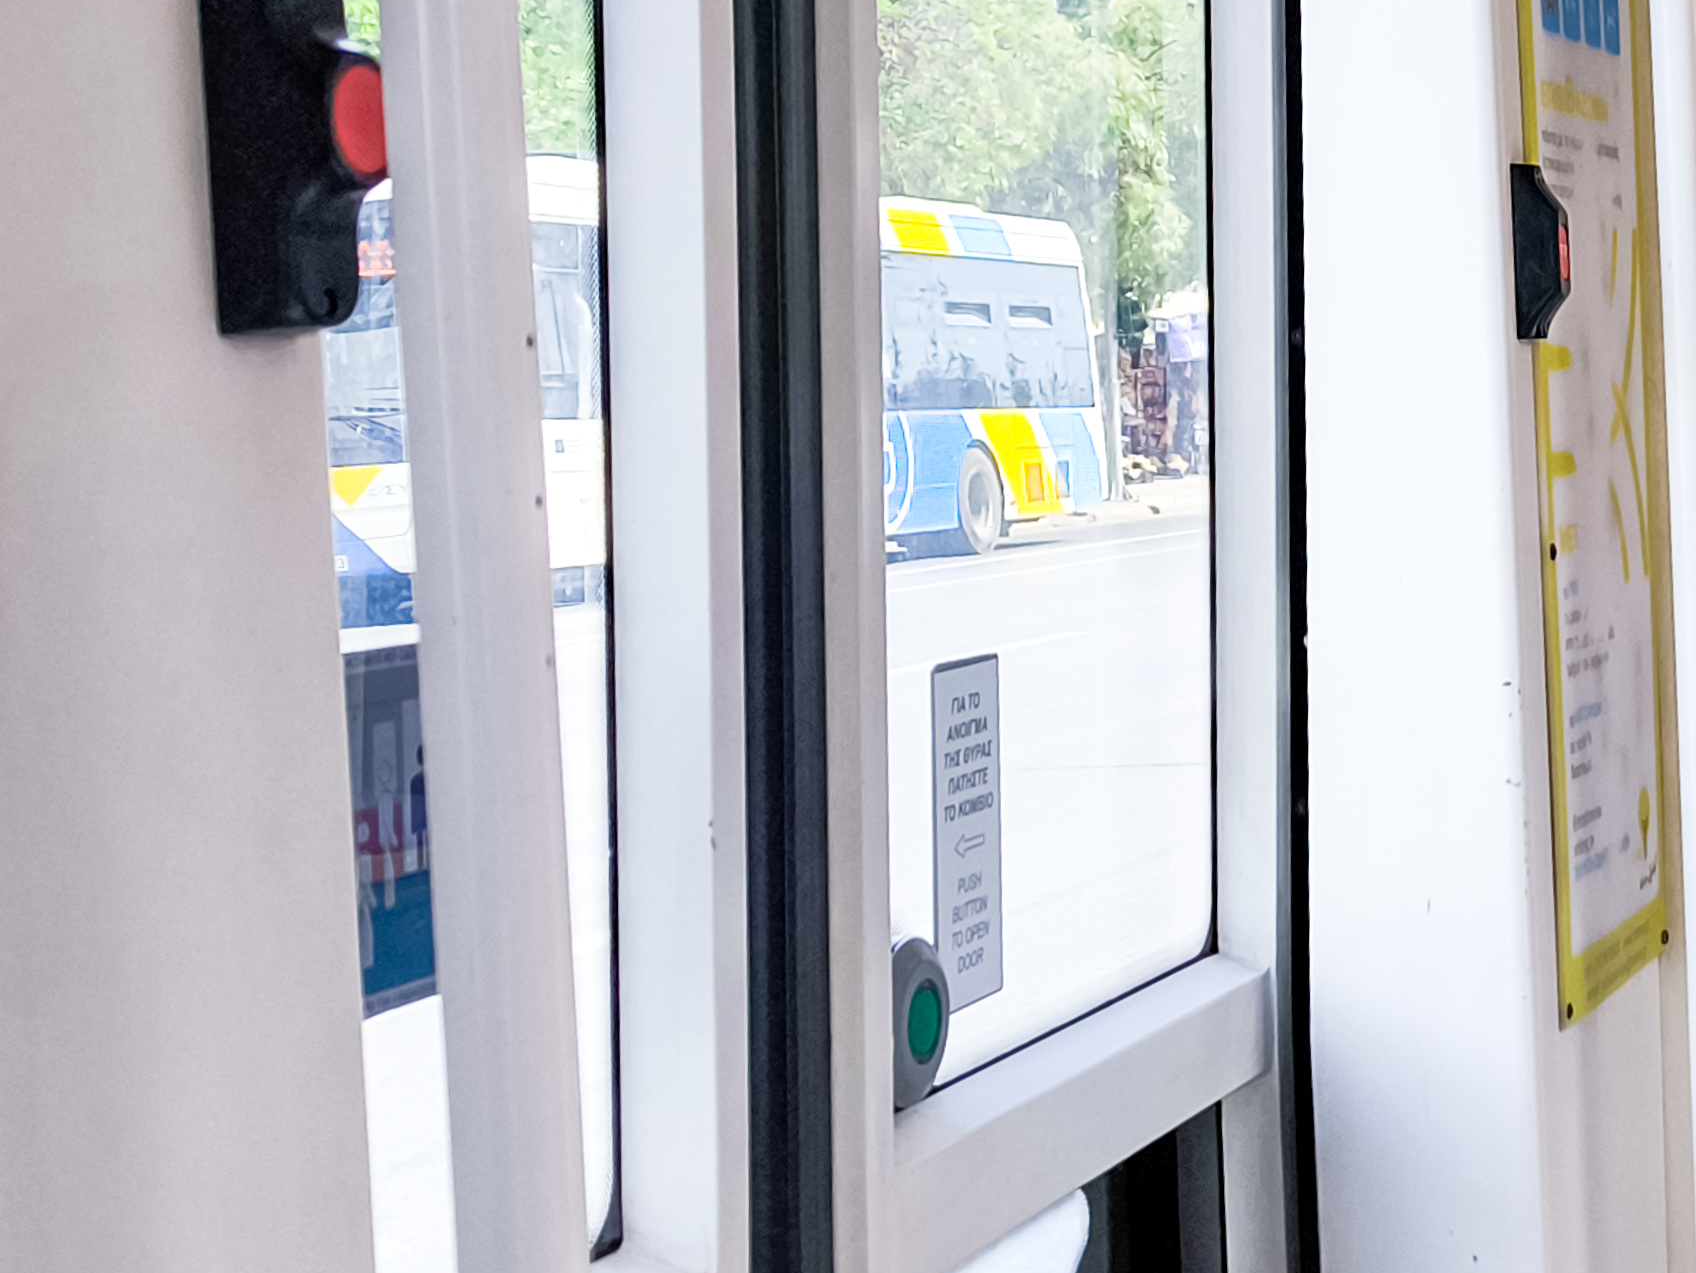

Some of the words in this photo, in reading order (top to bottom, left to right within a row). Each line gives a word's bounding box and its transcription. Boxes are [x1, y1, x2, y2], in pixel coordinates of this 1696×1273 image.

[951, 695, 966, 715] ΓΙΑ
[967, 691, 980, 711] ΤΟ
[946, 715, 988, 743] ΑΝΟΙΓΜΑ
[944, 749, 961, 769] ΤΗΣ
[963, 739, 992, 764] ΘΥΡΑΣ
[947, 766, 989, 796] ΠΑΤΗΣΤΕ
[943, 804, 956, 824] ΤΟ
[957, 791, 994, 818] ΚΟΜΒΙΟ
[957, 871, 982, 895] PUSH
[952, 895, 988, 924] BUTTON
[952, 930, 963, 949] TO
[965, 920, 990, 944] OPEN
[957, 946, 984, 974] DOOR
